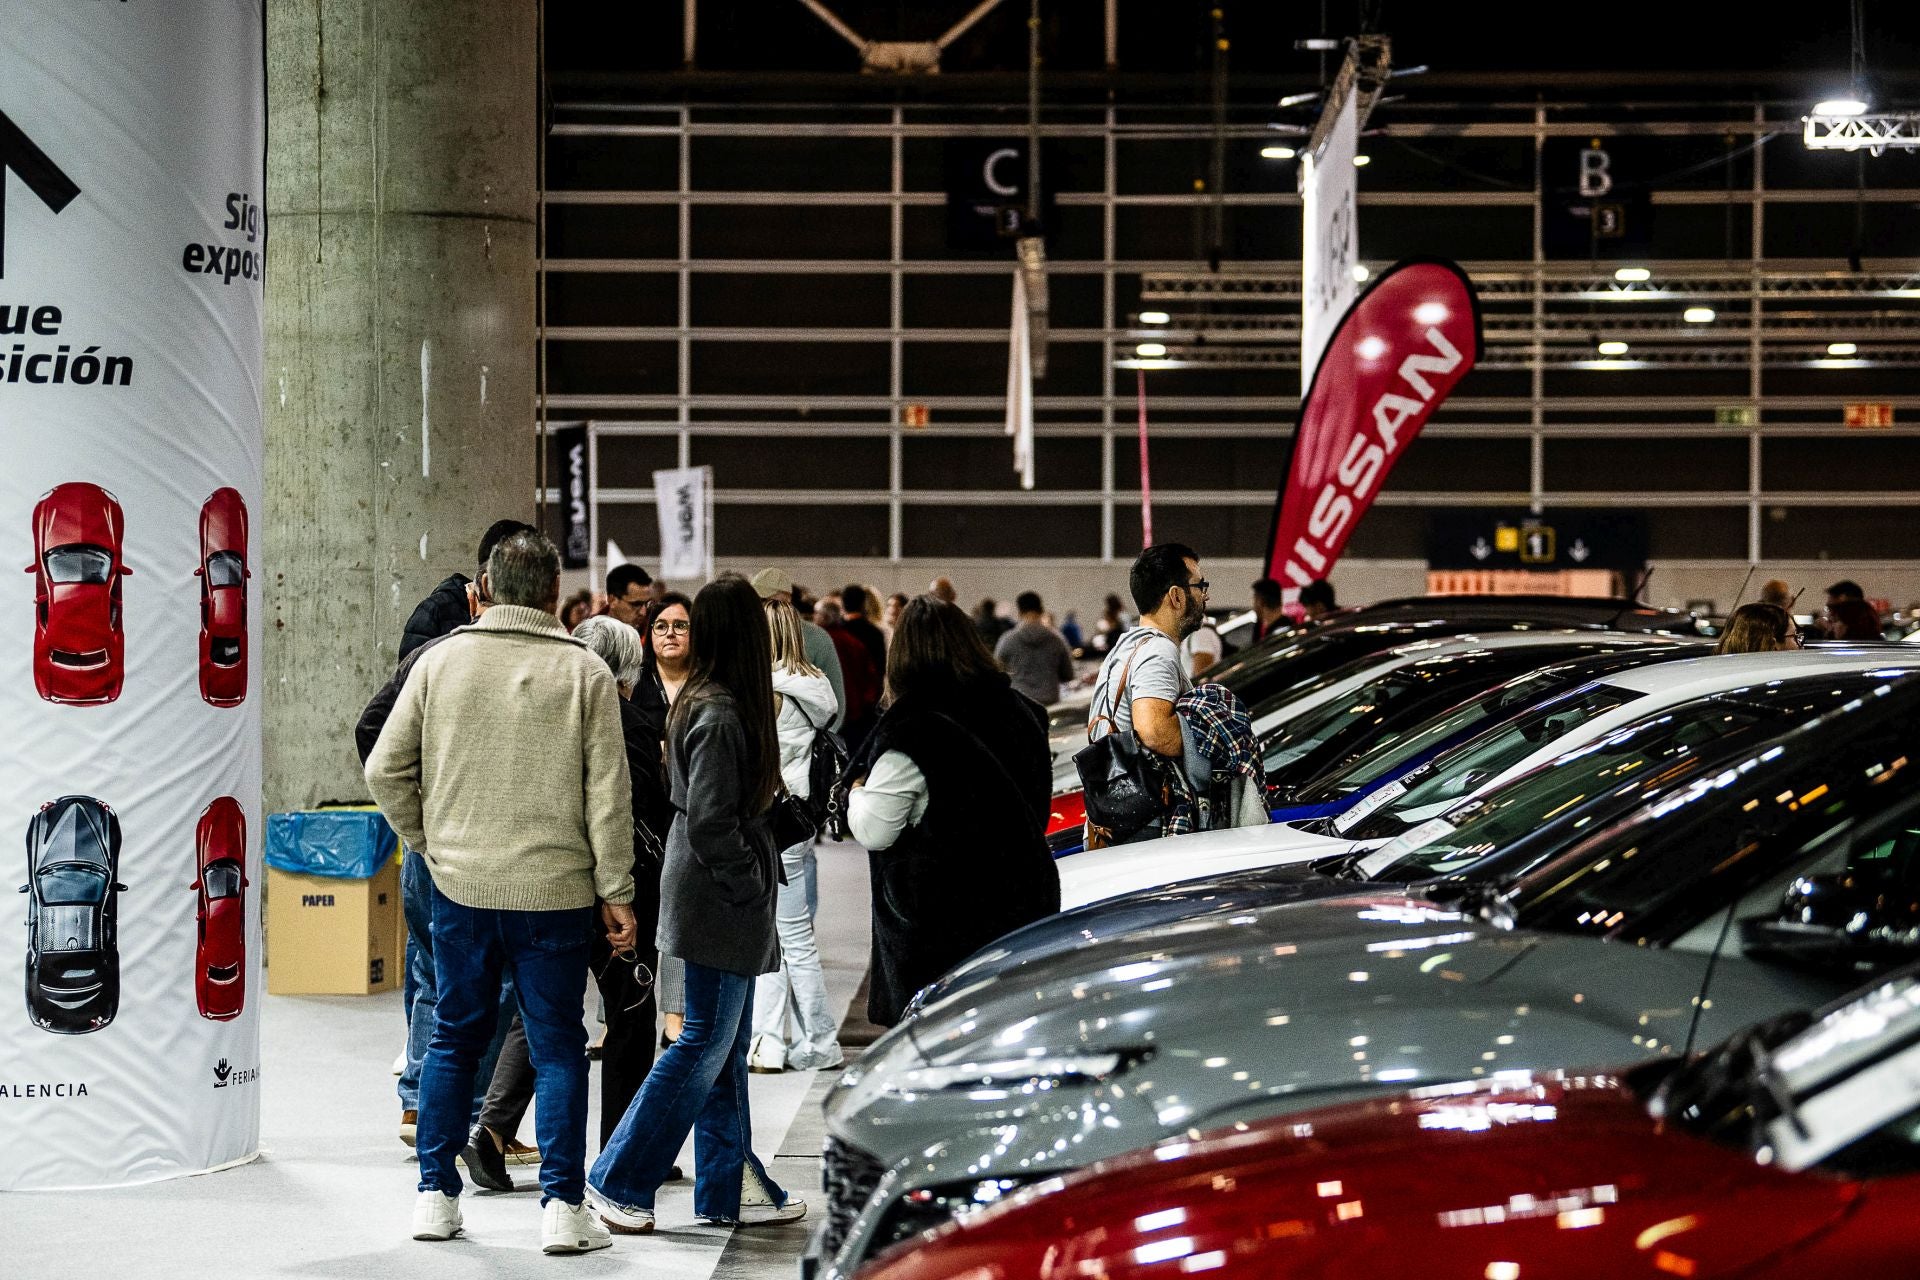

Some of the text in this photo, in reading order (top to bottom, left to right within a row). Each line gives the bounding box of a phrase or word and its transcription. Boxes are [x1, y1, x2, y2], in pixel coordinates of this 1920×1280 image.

[983, 148, 1019, 196] C
[1580, 149, 1612, 197] B
[224, 192, 260, 242] Sig
[0, 344, 133, 386] ición
[302, 894, 335, 907] PAPER
